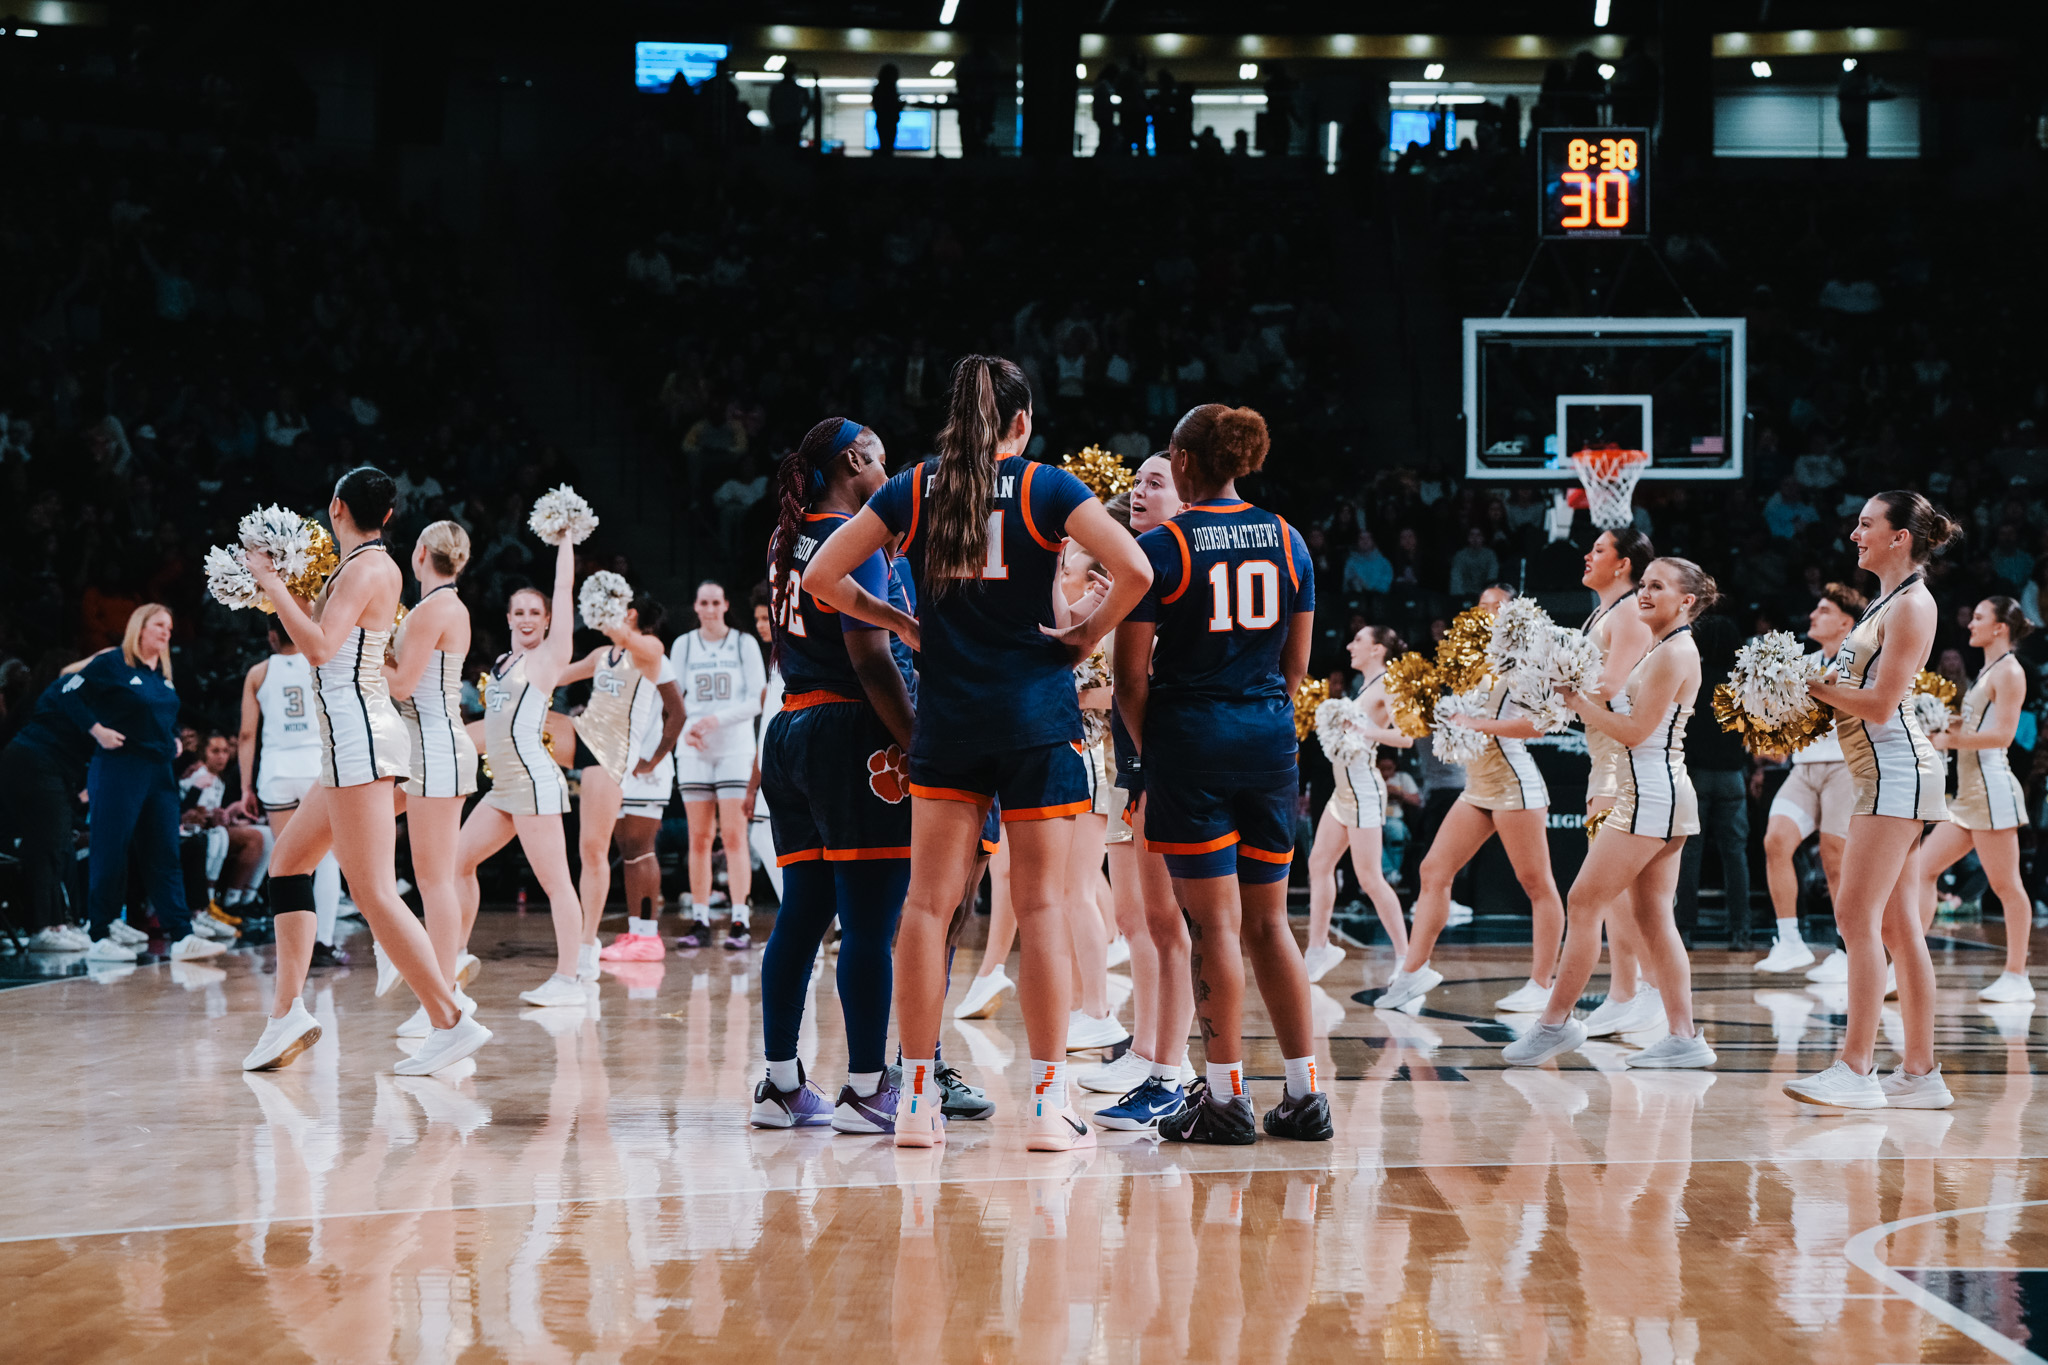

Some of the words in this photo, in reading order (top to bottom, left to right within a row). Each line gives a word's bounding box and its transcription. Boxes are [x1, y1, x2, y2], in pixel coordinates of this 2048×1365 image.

[1568, 139, 1637, 170] 8:30
[1561, 172, 1629, 227] 30
[1486, 440, 1524, 455] ACC
[1193, 523, 1279, 552] JOHNSON-MATTHEWS
[1208, 559, 1280, 633] 10
[485, 684, 511, 713] GT
[594, 670, 626, 697] GT
[694, 672, 732, 702] 20
[283, 685, 305, 718] 3
